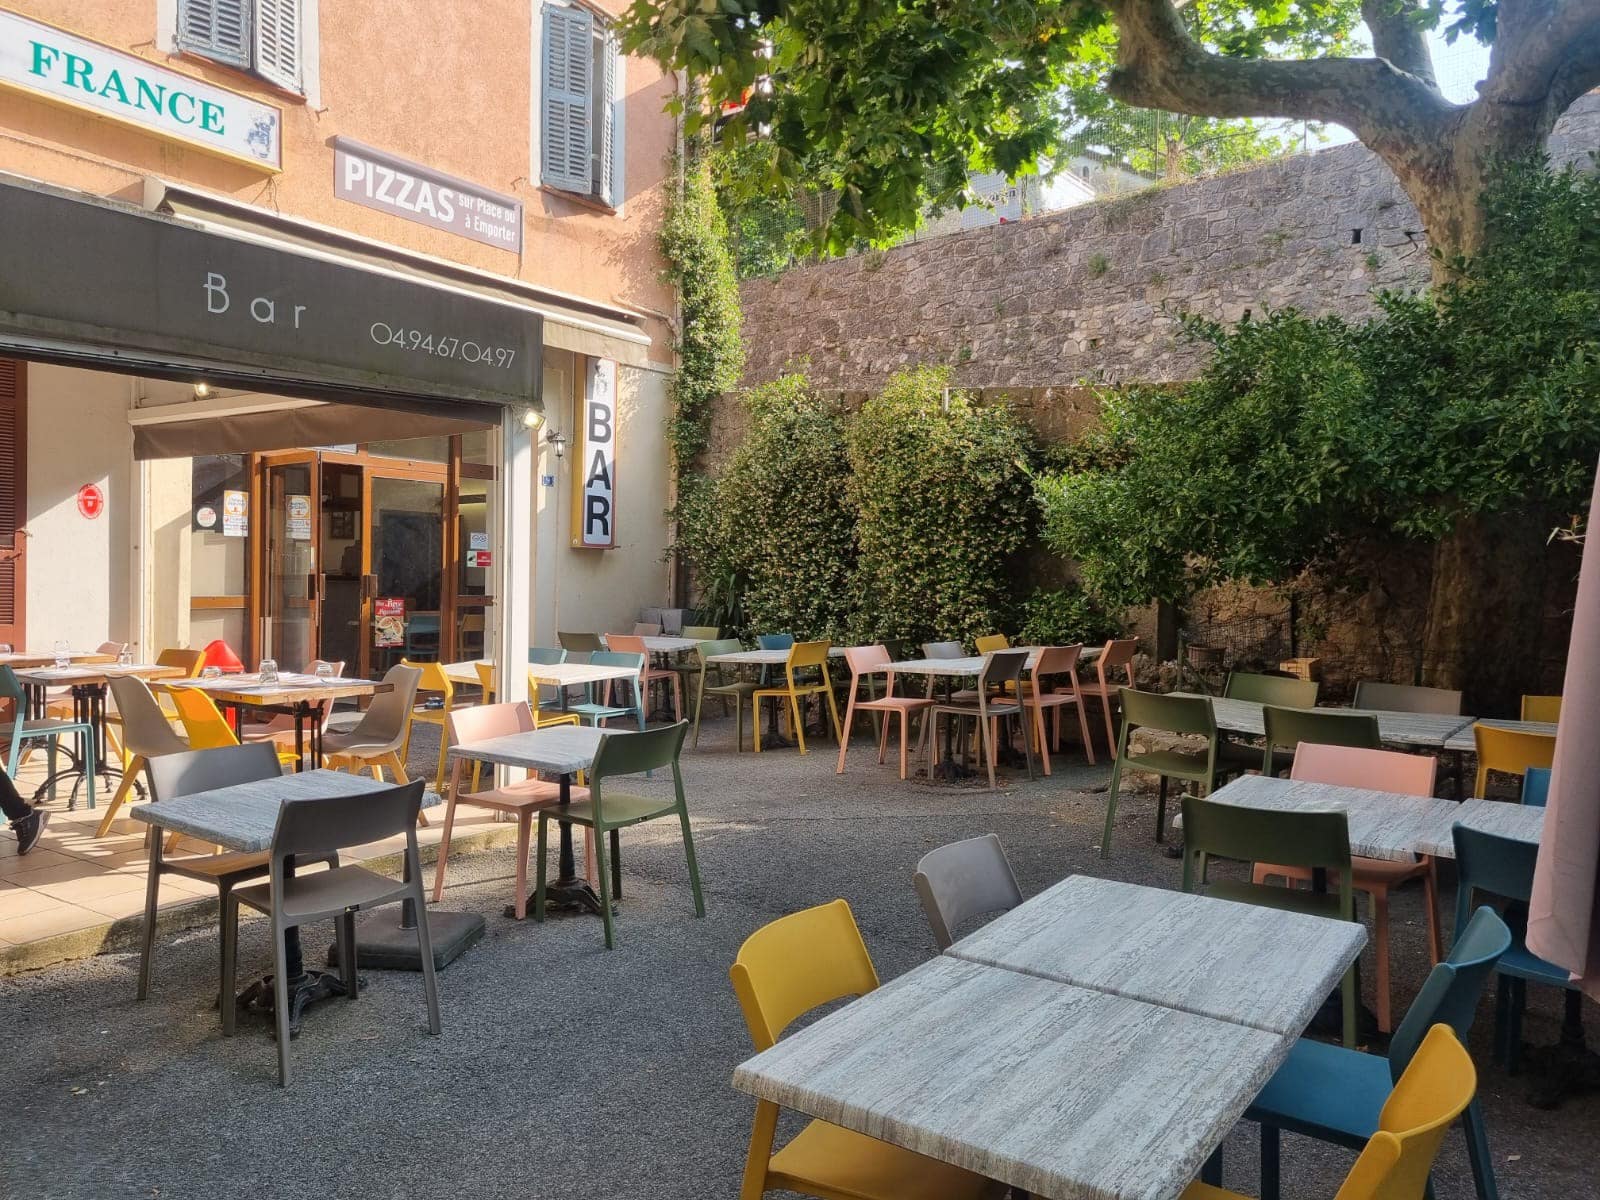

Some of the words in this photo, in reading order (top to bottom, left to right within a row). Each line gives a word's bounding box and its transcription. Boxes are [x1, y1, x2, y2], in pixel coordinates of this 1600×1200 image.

[28, 40, 225, 135] FRANCE
[344, 155, 455, 222] PIZZAS
[458, 193, 474, 209] sur
[477, 198, 502, 219] Place
[504, 209, 516, 223] ou
[465, 213, 471, 228] à
[474, 215, 516, 242] Emporter
[203, 272, 306, 328] Bar
[370, 322, 516, 369] 04.94.67.04.97
[586, 401, 612, 536] BAR
